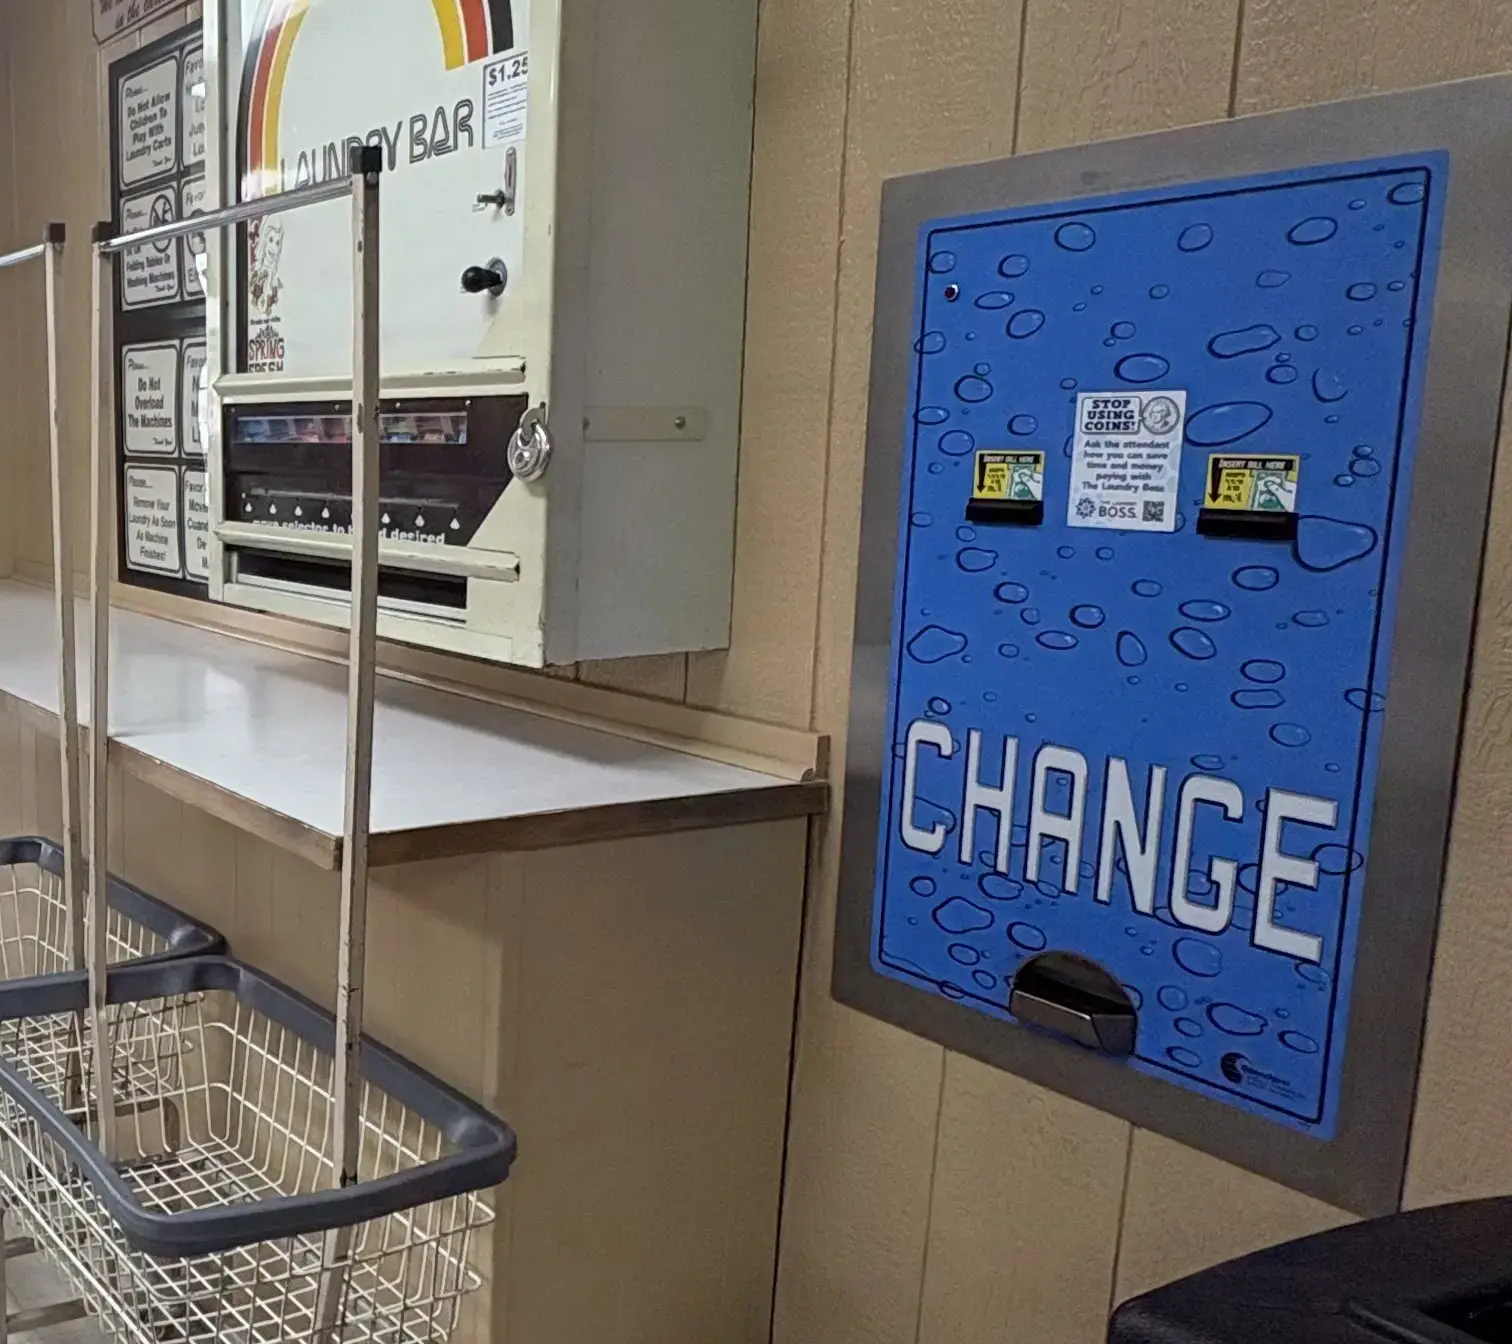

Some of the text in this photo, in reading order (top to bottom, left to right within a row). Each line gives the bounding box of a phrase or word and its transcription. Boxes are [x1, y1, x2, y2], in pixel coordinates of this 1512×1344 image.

[115, 14, 124, 29] in
[128, 3, 140, 23] the
[488, 56, 528, 87] $1.25
[128, 92, 170, 119] Do Not Allow
[130, 107, 168, 131] Children To
[133, 123, 164, 145] Play With
[409, 98, 474, 164] BAR
[126, 136, 171, 161] Laundry Carts
[249, 337, 285, 360] SPRING
[138, 377, 160, 392] Do Not
[135, 395, 164, 410] Overload
[1092, 399, 1131, 409] STOP
[128, 413, 172, 428] The Machines
[1087, 410, 1135, 420] USING
[1084, 421, 1136, 431] COINS!
[1084, 440, 1170, 449] Ask the attendant
[1083, 450, 1104, 459] how
[1106, 452, 1124, 460] you
[1086, 461, 1163, 473] time and money
[1130, 472, 1152, 480] with
[1082, 481, 1098, 490] The
[1101, 482, 1139, 493] Laundry
[133, 496, 171, 511] Remove Your
[129, 515, 176, 529] Laundry As Soon
[136, 529, 168, 546] As Machine
[390, 528, 445, 544] desired
[899, 717, 1340, 964] CHANGE
